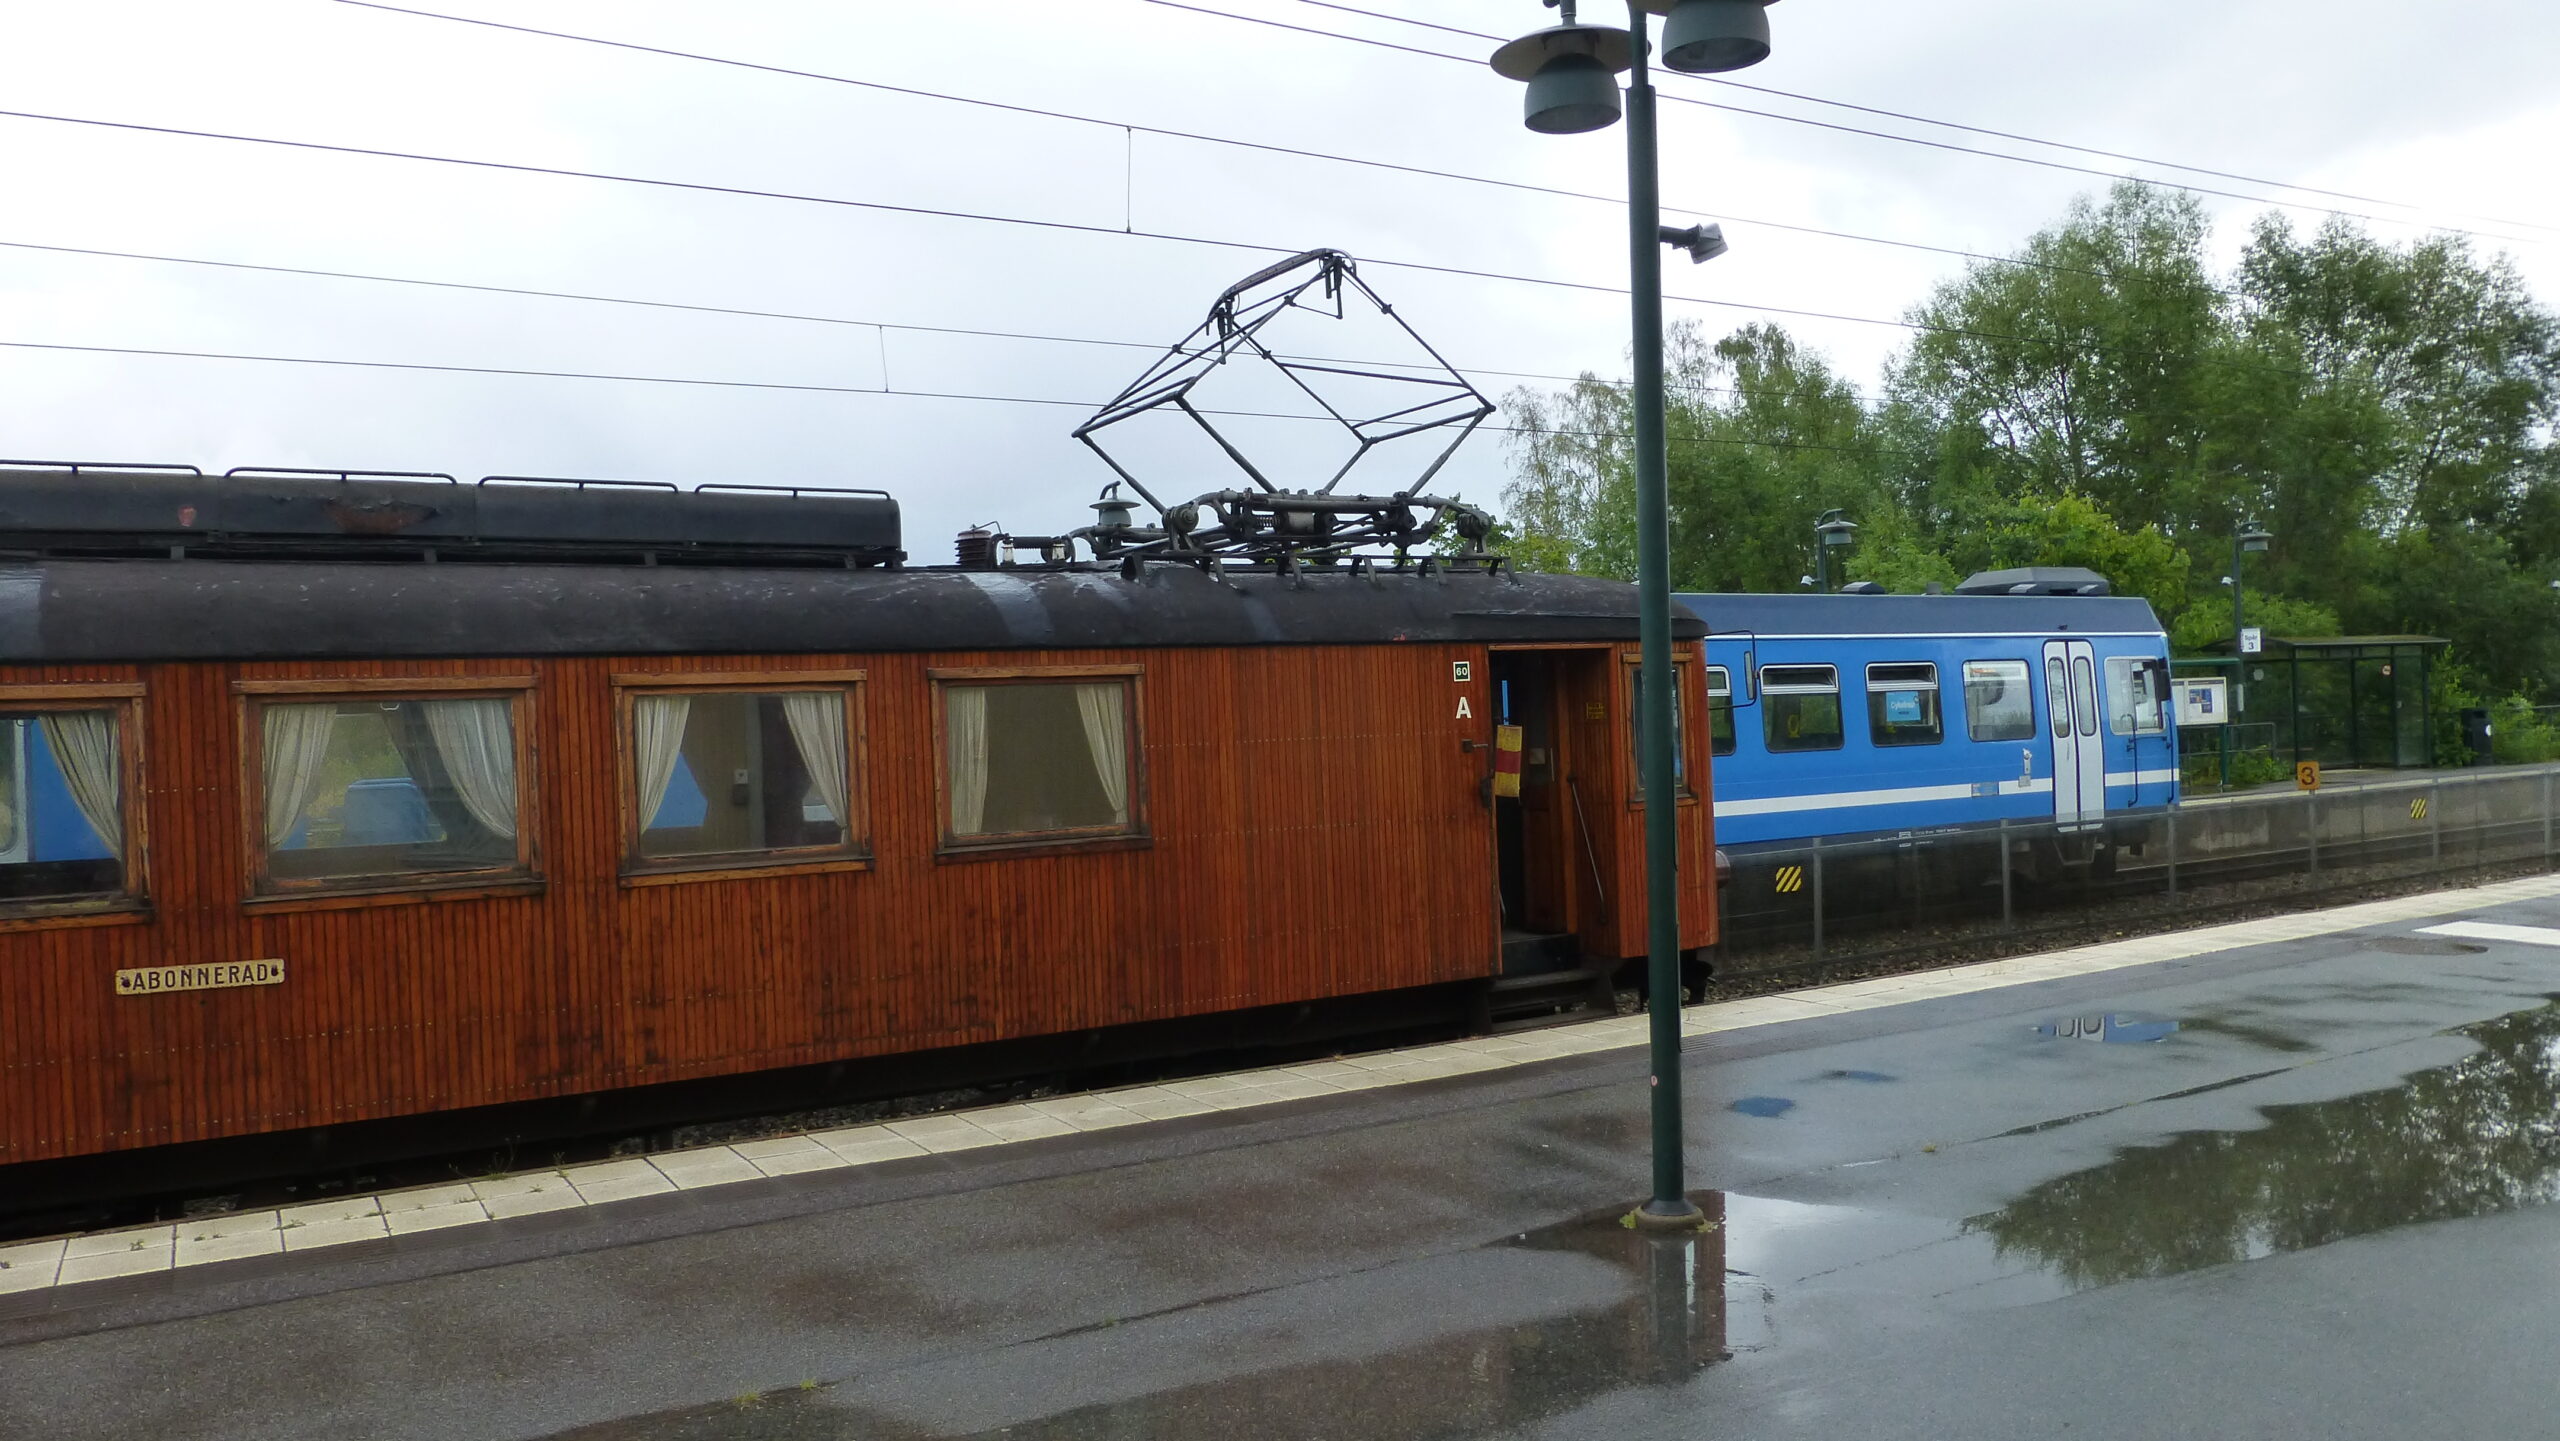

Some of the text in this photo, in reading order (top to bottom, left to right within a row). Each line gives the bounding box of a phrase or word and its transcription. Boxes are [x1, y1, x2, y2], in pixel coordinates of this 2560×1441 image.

[2248, 641, 2255, 650] 3
[1456, 667, 1468, 676] 60
[1455, 696, 1472, 719] A
[2301, 766, 2315, 785] 3
[132, 963, 268, 991] ABONNERAD
